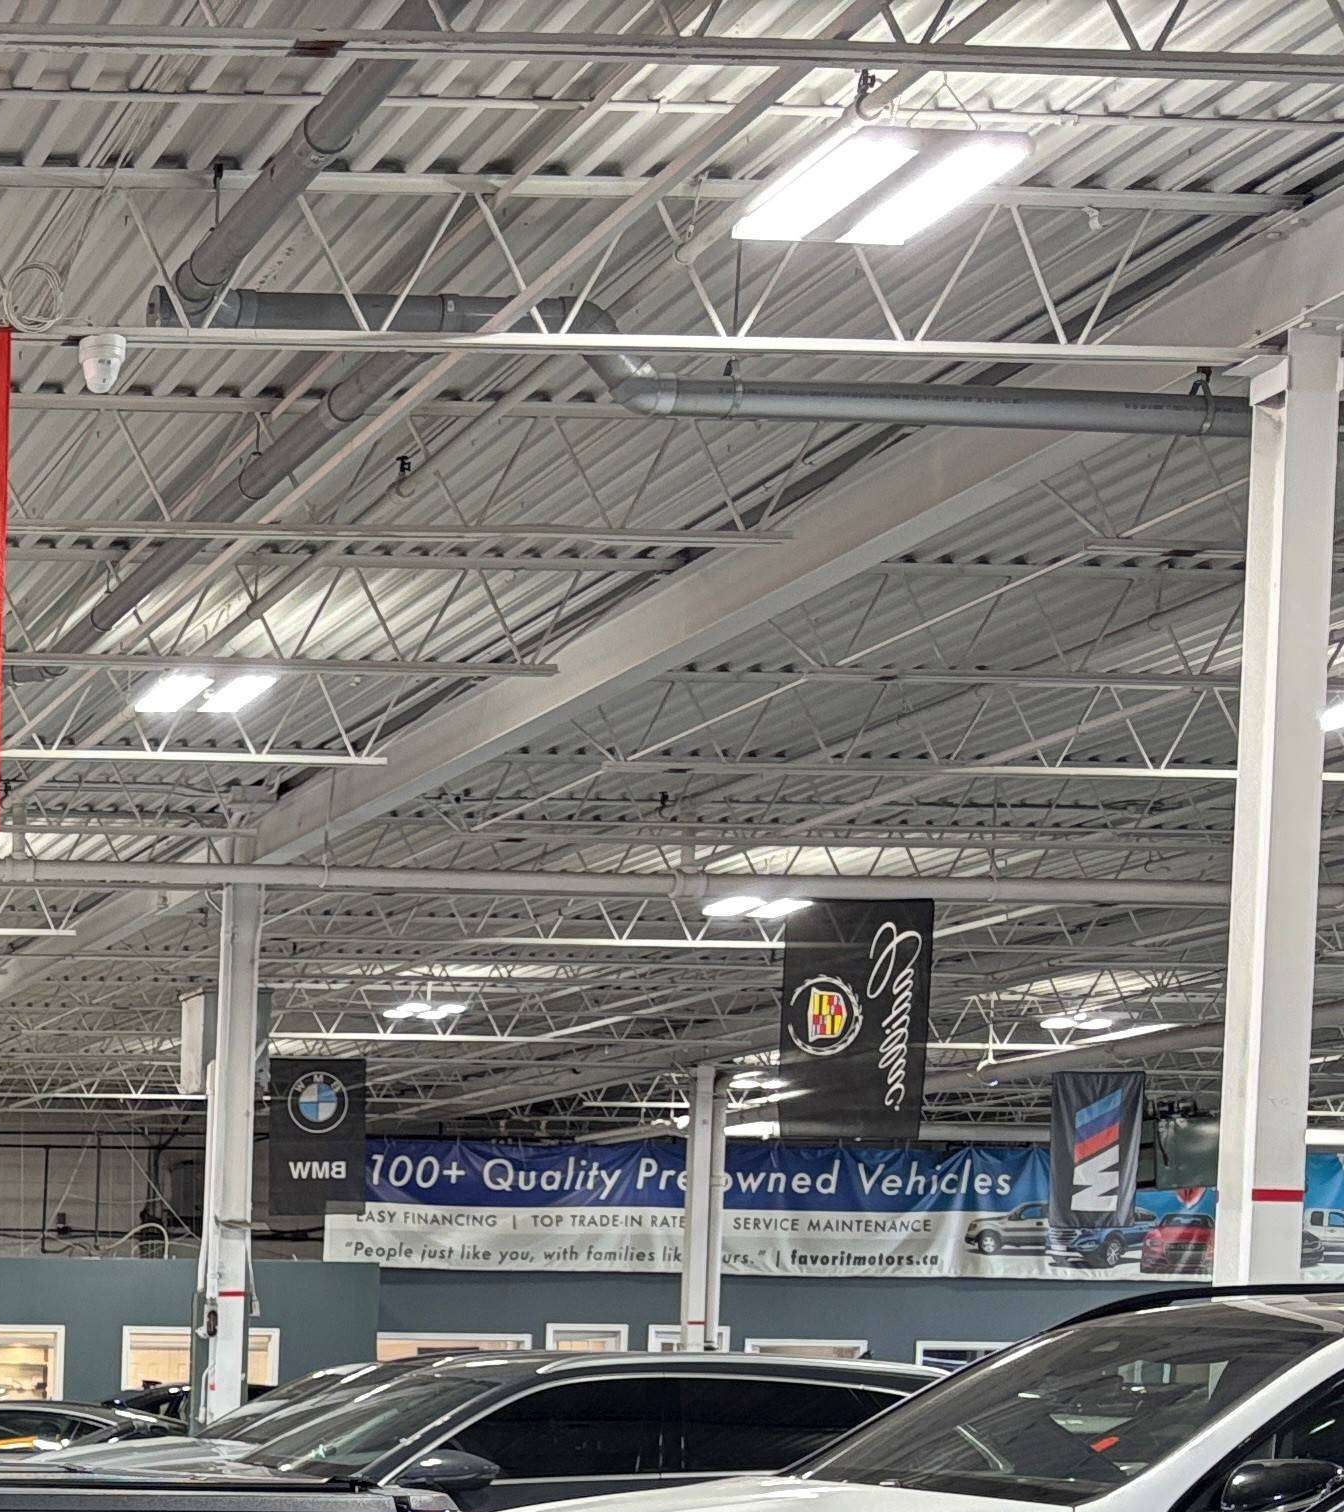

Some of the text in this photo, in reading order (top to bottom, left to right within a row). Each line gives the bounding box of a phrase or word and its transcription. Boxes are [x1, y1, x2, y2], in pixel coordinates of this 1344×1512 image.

[369, 1154, 466, 1189] 100+
[483, 1157, 622, 1200] Quality
[857, 1159, 1011, 1197] Vehicles
[356, 1210, 932, 1233] EASY FINANCING TOP TRADE-IN RATE SERVICE MAINTENANCE
[420, 1243, 453, 1264] just
[460, 1243, 494, 1261] like
[499, 1249, 535, 1265] you,
[543, 1245, 579, 1261] with
[585, 1244, 655, 1263] families
[662, 1246, 682, 1262] lik
[790, 1250, 939, 1267] favoritmotors.ca
